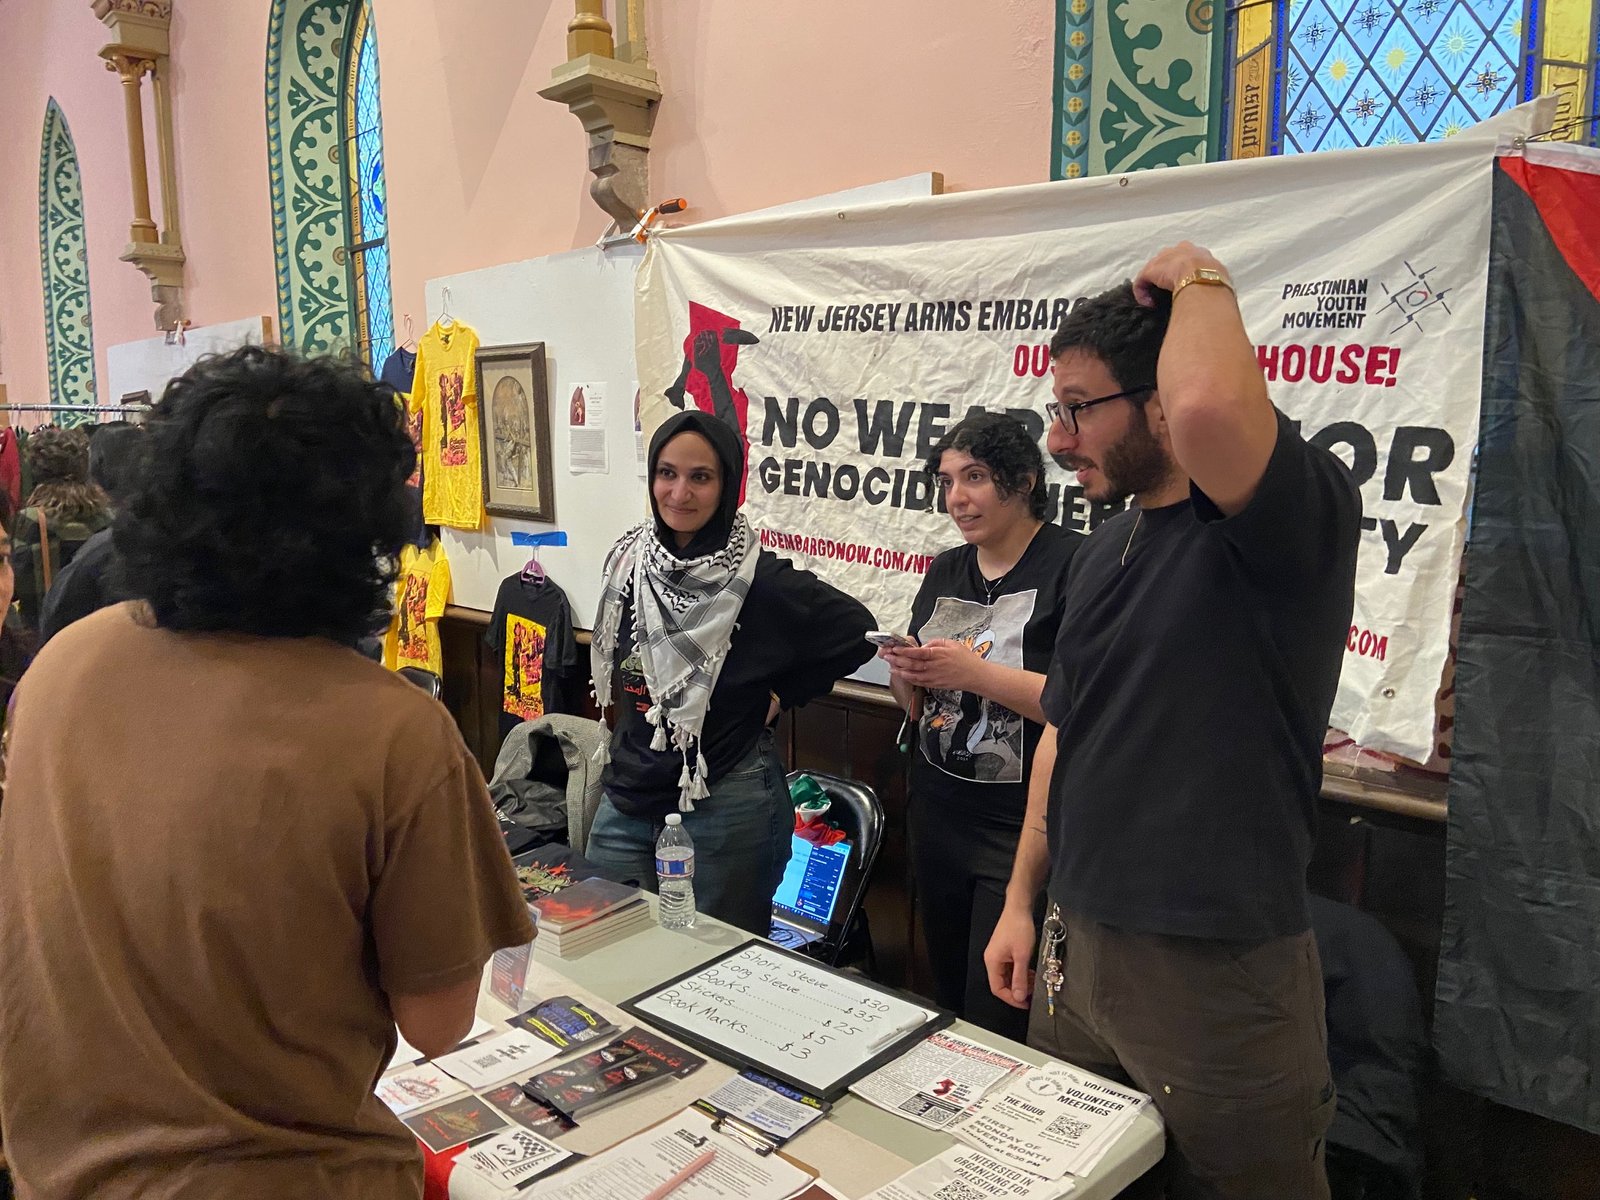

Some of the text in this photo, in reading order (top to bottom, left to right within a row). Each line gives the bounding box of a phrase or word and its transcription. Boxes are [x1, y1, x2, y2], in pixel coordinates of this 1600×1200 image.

[1282, 279, 1368, 299] PALESTINIAN
[1317, 297, 1366, 311] YOUTH
[769, 305, 815, 333] NEW
[818, 302, 901, 333] JERSEY
[904, 300, 972, 332] ARMS
[1282, 313, 1366, 328] MOVEMENT
[1013, 344, 1055, 378] OU
[762, 397, 840, 449] NO
[1290, 420, 1455, 505] OR
[755, 528, 936, 574] MSEMBARGONOW.COM/NE
[1361, 516, 1428, 574] Y
[721, 959, 882, 1022] Long Sleeve $35
[740, 950, 890, 1012] Short Sleeve $30
[656, 989, 812, 1060] Book Marks $3
[680, 980, 836, 1045] Stickers $5
[822, 1019, 863, 1036] $25
[1003, 1095, 1020, 1107] THE
[1020, 1103, 1046, 1116] HUUB
[1057, 1095, 1111, 1117] MEETINGS
[1066, 1087, 1125, 1111] VOLUNTEER
[974, 1120, 1023, 1143] MONDAY
[1024, 1142, 1042, 1150] OF
[981, 1115, 1014, 1132] FIRST
[961, 1127, 994, 1149] starting
[1005, 1152, 1025, 1161] 6:30
[1026, 1160, 1041, 1168] PM
[968, 1124, 1051, 1162] EVERY MONTH
[954, 1157, 1030, 1197] ORGANIZING FOR
[954, 1167, 1008, 1197] PALESTINE?
[969, 1152, 1034, 1187] INTERESTED IN
